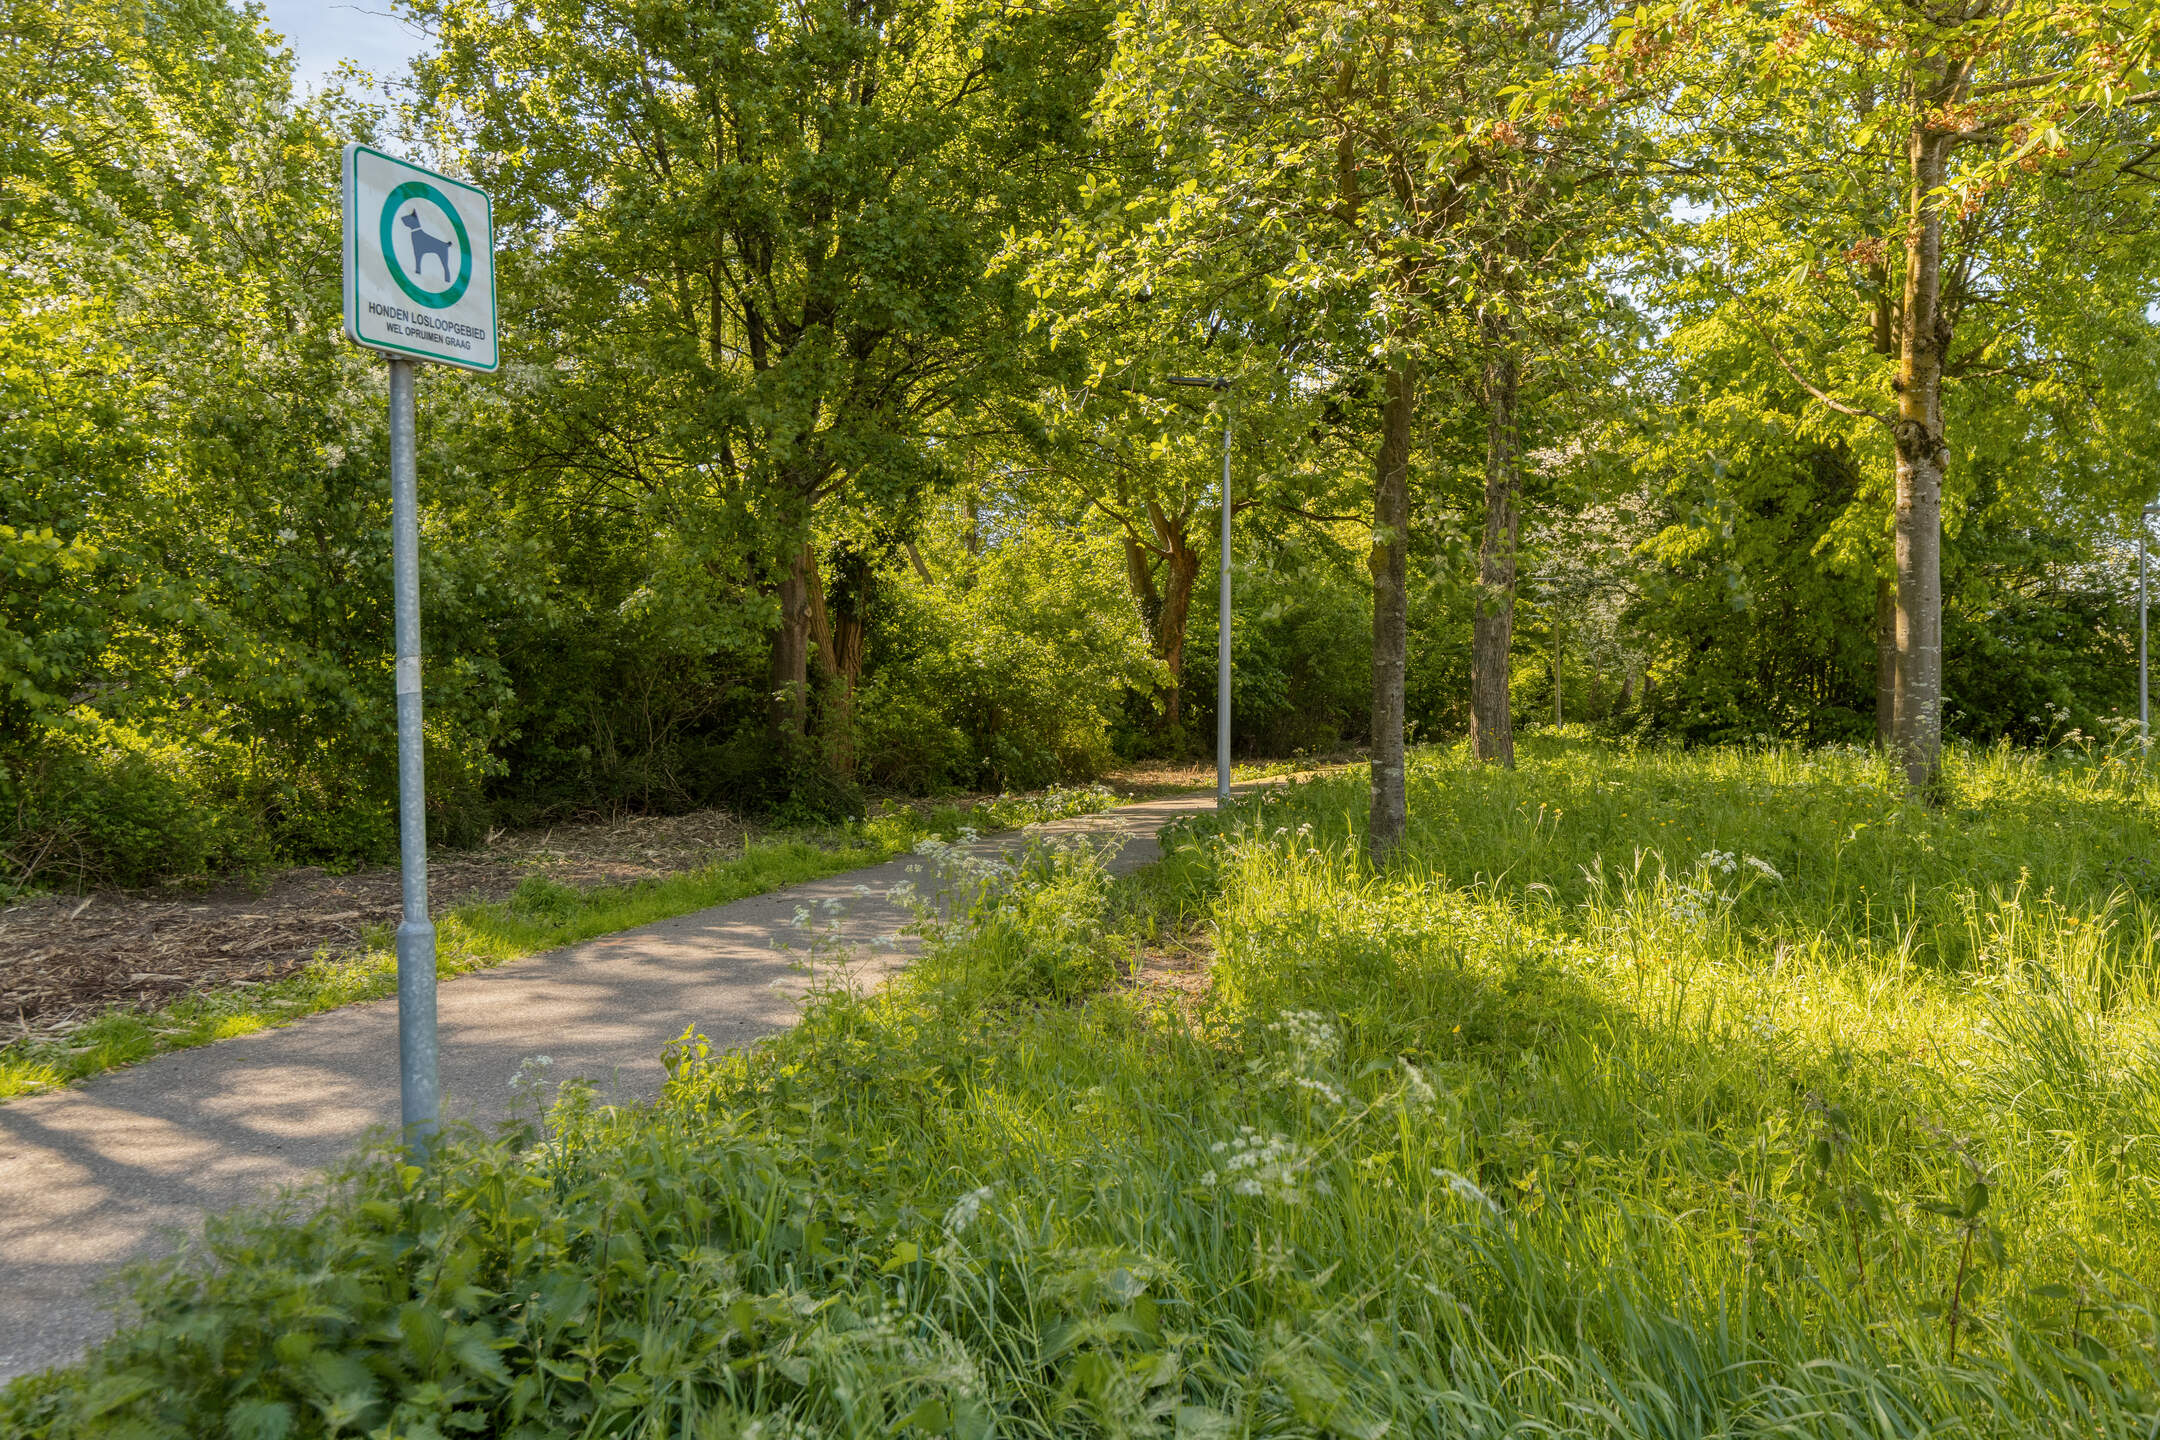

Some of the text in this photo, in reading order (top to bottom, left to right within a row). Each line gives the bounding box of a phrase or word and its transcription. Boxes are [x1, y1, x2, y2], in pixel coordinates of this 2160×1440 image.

[368, 302, 486, 340] HONDEN LOSLOOPGEBIED
[386, 322, 471, 350] WEL OPRUIMEN GRAAG
